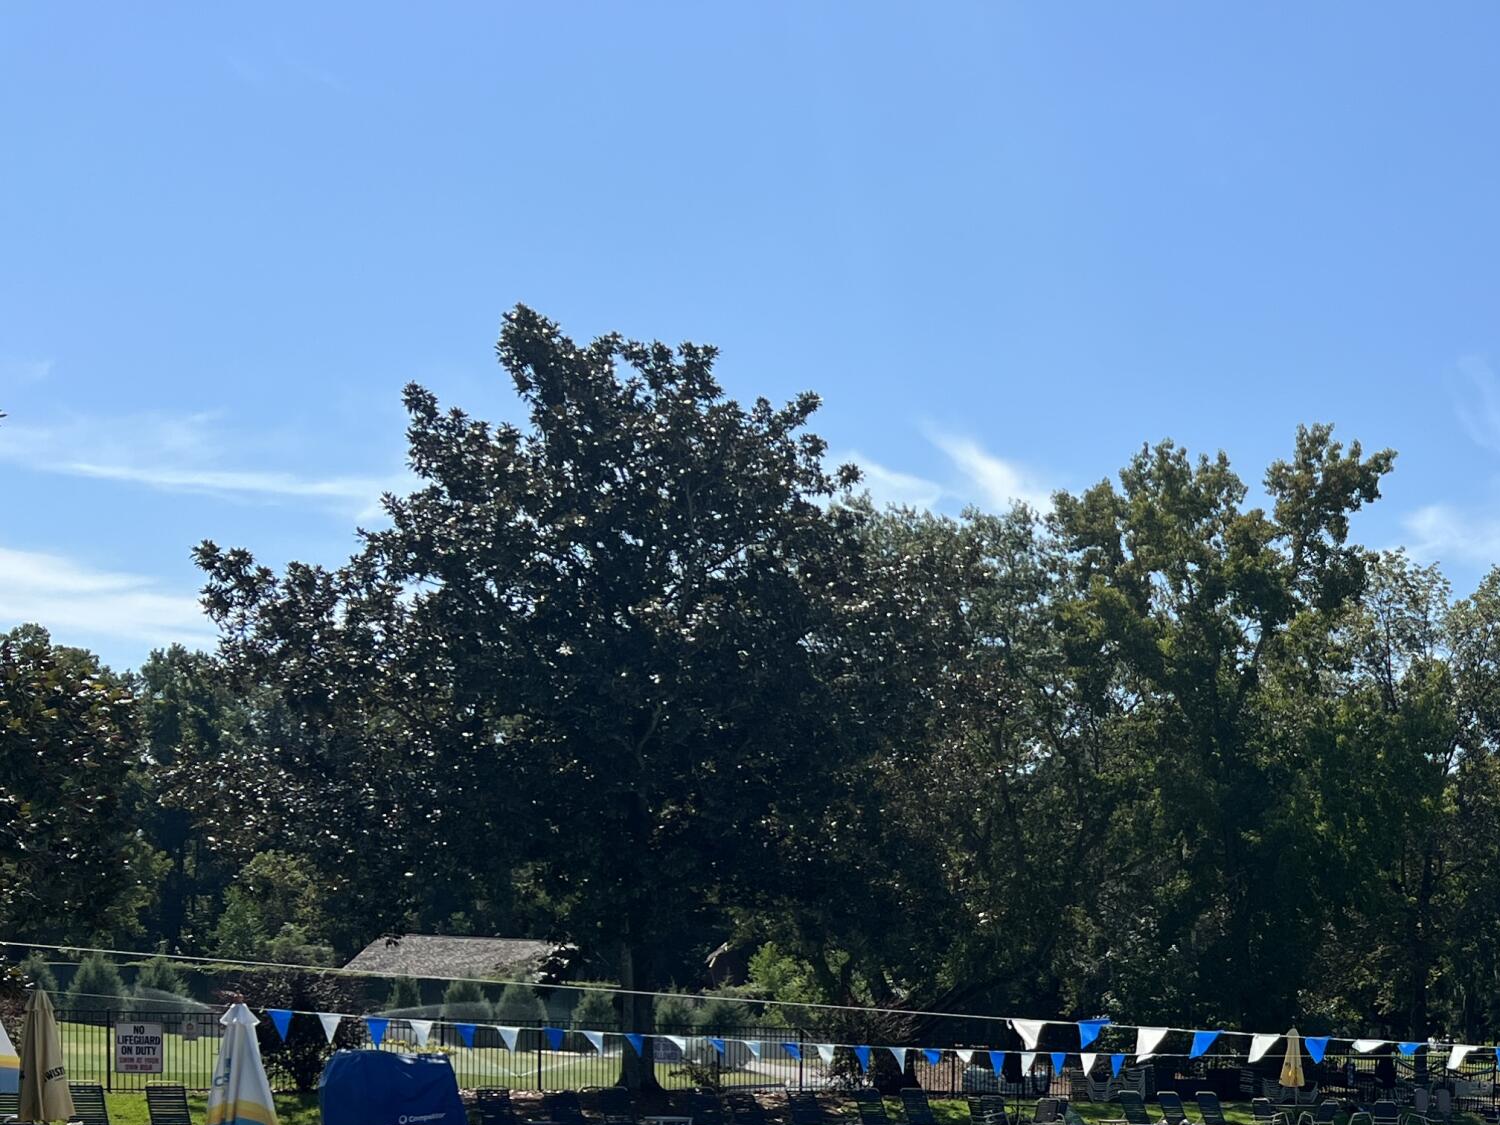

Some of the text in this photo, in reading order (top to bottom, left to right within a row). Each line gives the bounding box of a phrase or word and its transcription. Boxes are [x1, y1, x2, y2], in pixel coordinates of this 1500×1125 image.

[133, 1025, 145, 1034] NO
[117, 1035, 161, 1045] LIFEGUARD
[121, 1046, 157, 1056] ON DUTY
